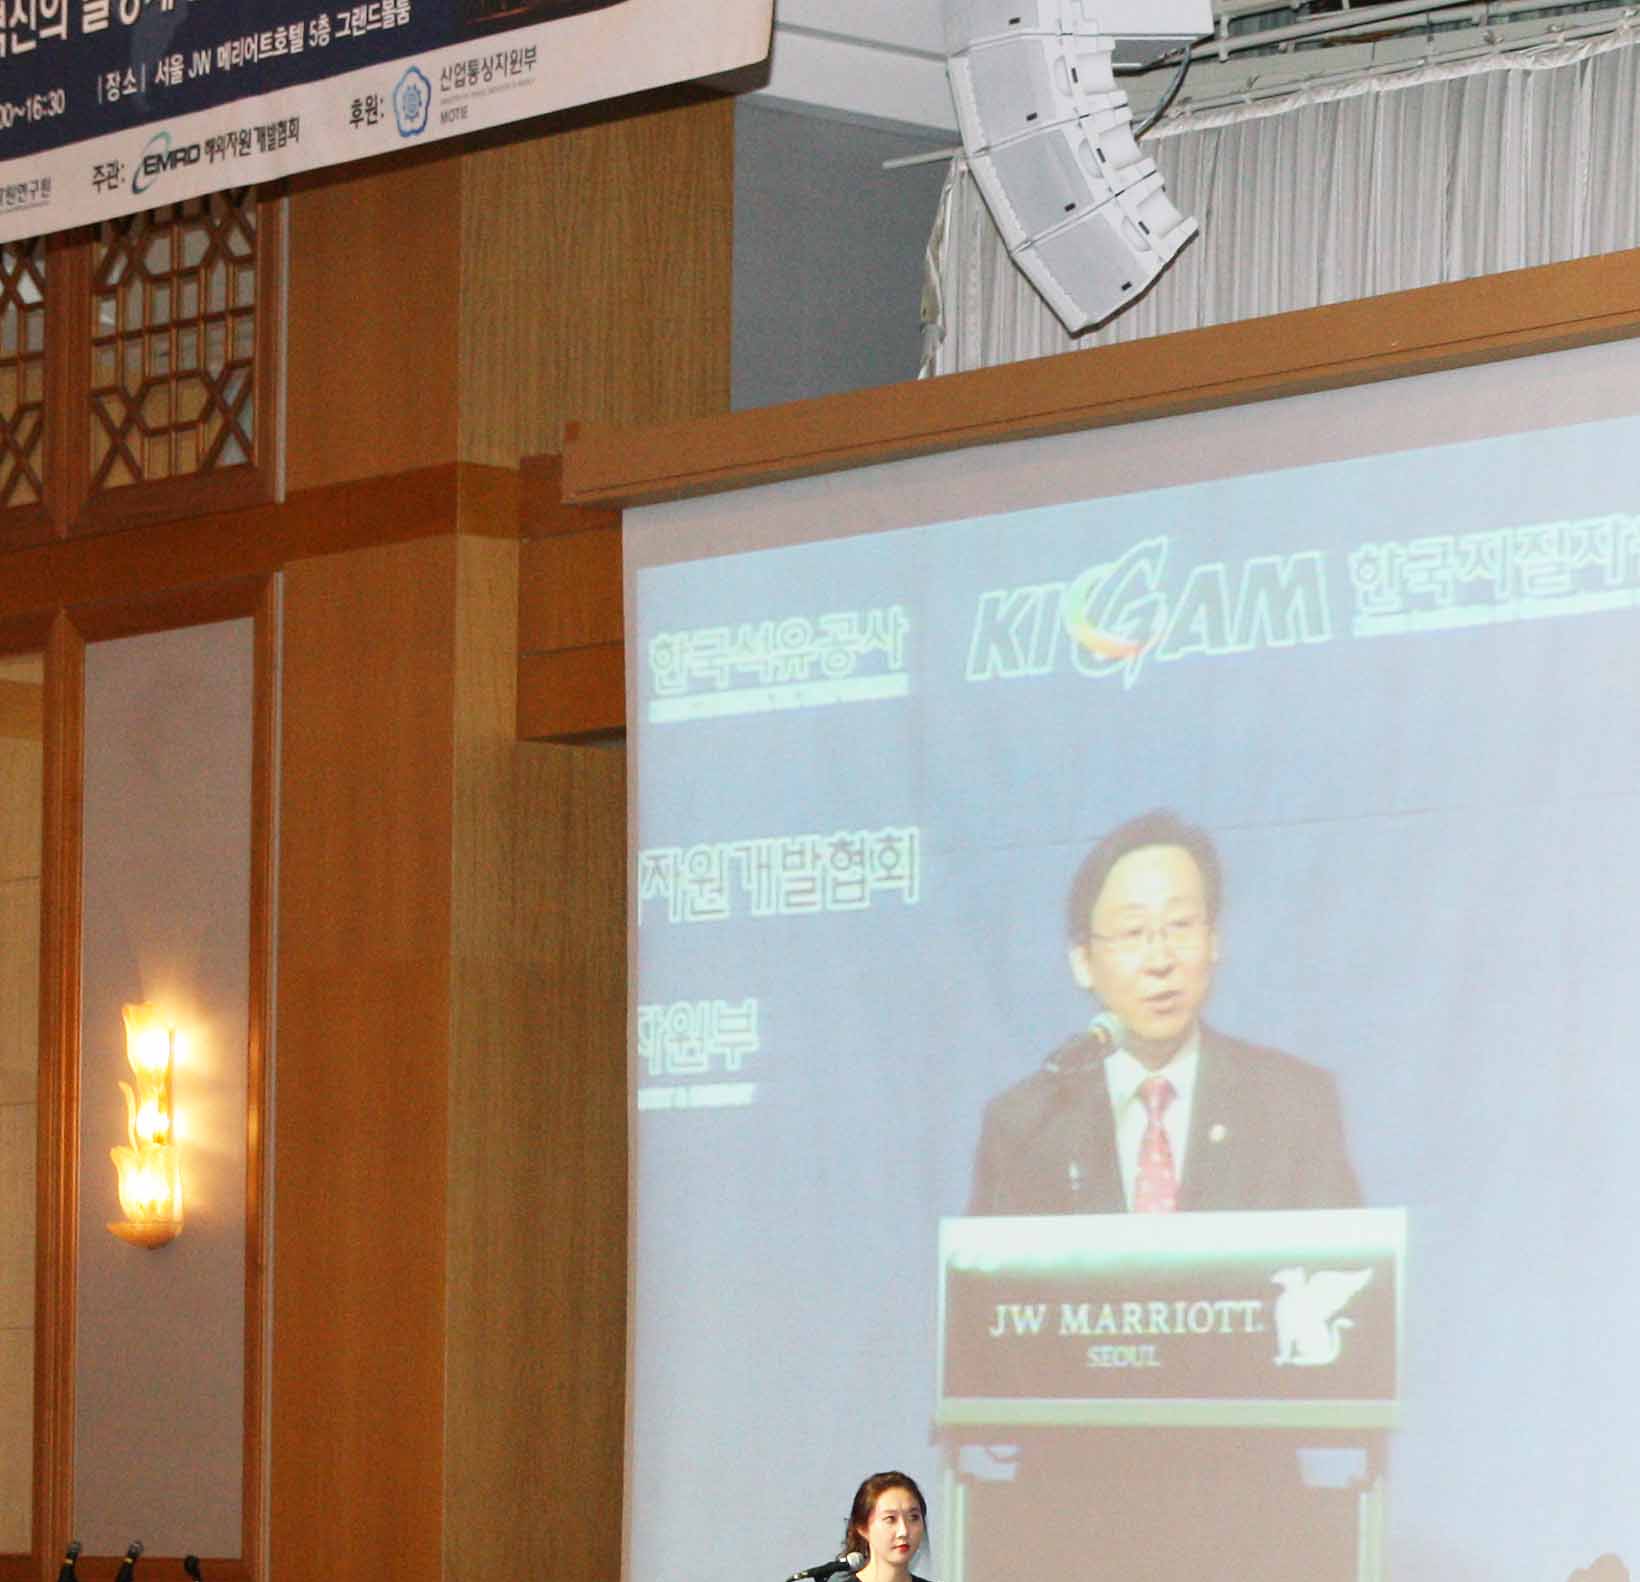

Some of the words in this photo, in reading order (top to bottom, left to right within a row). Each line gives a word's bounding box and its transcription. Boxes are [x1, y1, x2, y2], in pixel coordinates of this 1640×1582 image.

[106, 68, 137, 102] 장소
[155, 54, 184, 88] 서울
[188, 49, 212, 79] JW
[217, 21, 304, 72] 메리어트호텔
[308, 14, 331, 47] 5층
[335, 0, 411, 39] 그랜드볼룸
[440, 45, 538, 92] 산업통상자원부
[989, 1302, 1047, 1338] JW
[1058, 1300, 1263, 1337] MARRIOTT
[1086, 1345, 1161, 1368] SEOUL
